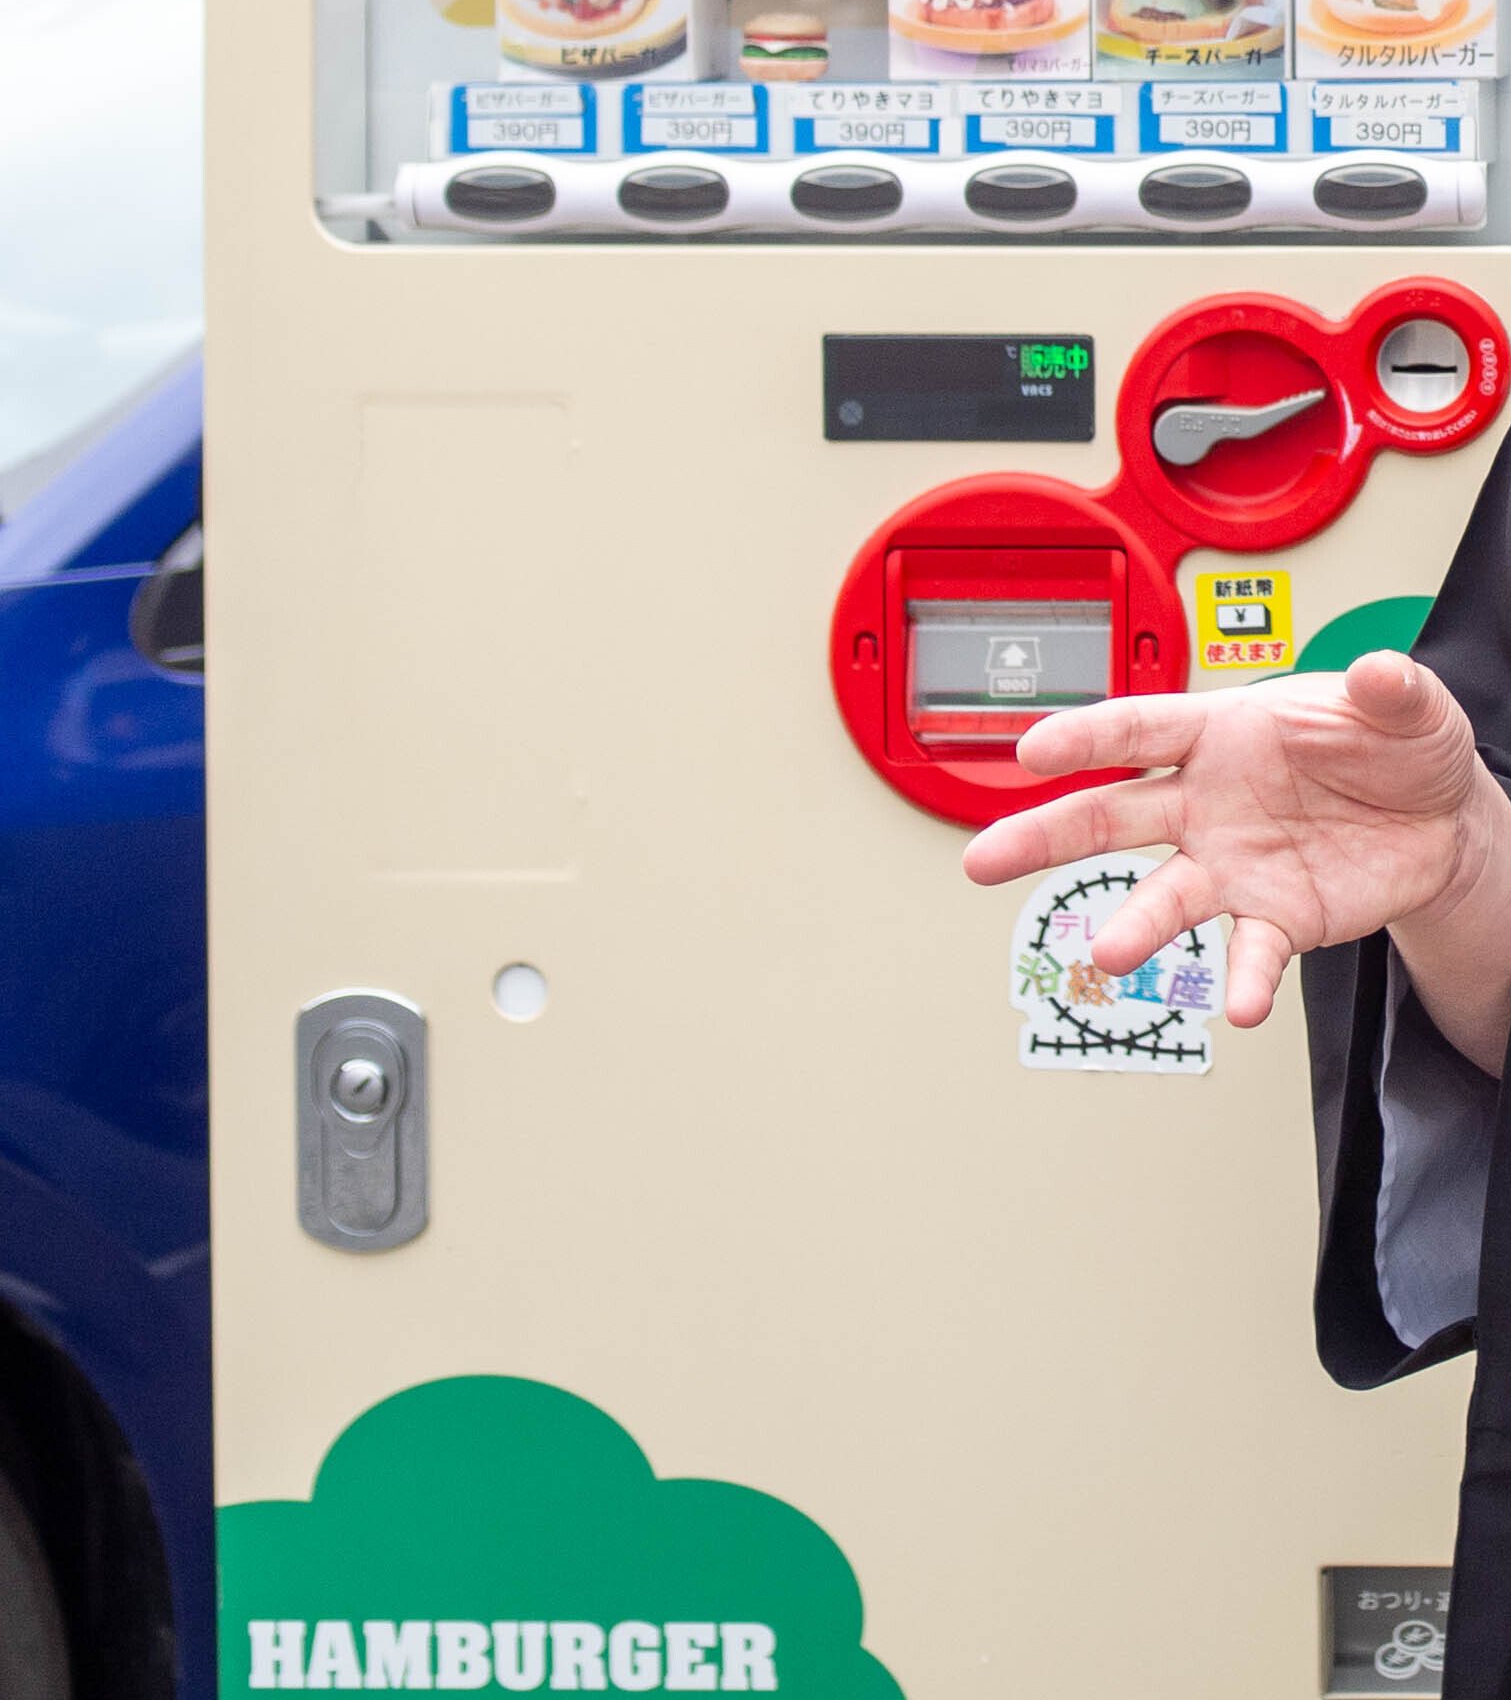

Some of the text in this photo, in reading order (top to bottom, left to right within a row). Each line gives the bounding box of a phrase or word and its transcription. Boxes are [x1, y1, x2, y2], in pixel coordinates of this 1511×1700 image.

[1336, 44, 1495, 68] タルタルバーガー
[808, 89, 935, 111] てりやきマヨ
[978, 88, 1103, 110] てりやきマヨ
[1160, 86, 1271, 106] チーズバーガー
[1320, 90, 1459, 111] タルタルバーガー
[493, 121, 559, 144] 390円
[665, 120, 732, 143] 390円
[839, 120, 906, 144] 390円
[1005, 119, 1072, 142] 390円
[1184, 119, 1252, 142] 390円
[1355, 121, 1423, 144] 390円
[1020, 343, 1088, 380] 販売中
[1215, 579, 1273, 598] 新紙幣
[1206, 641, 1287, 663] 使えます
[247, 1619, 779, 1693] HAMBURGER
